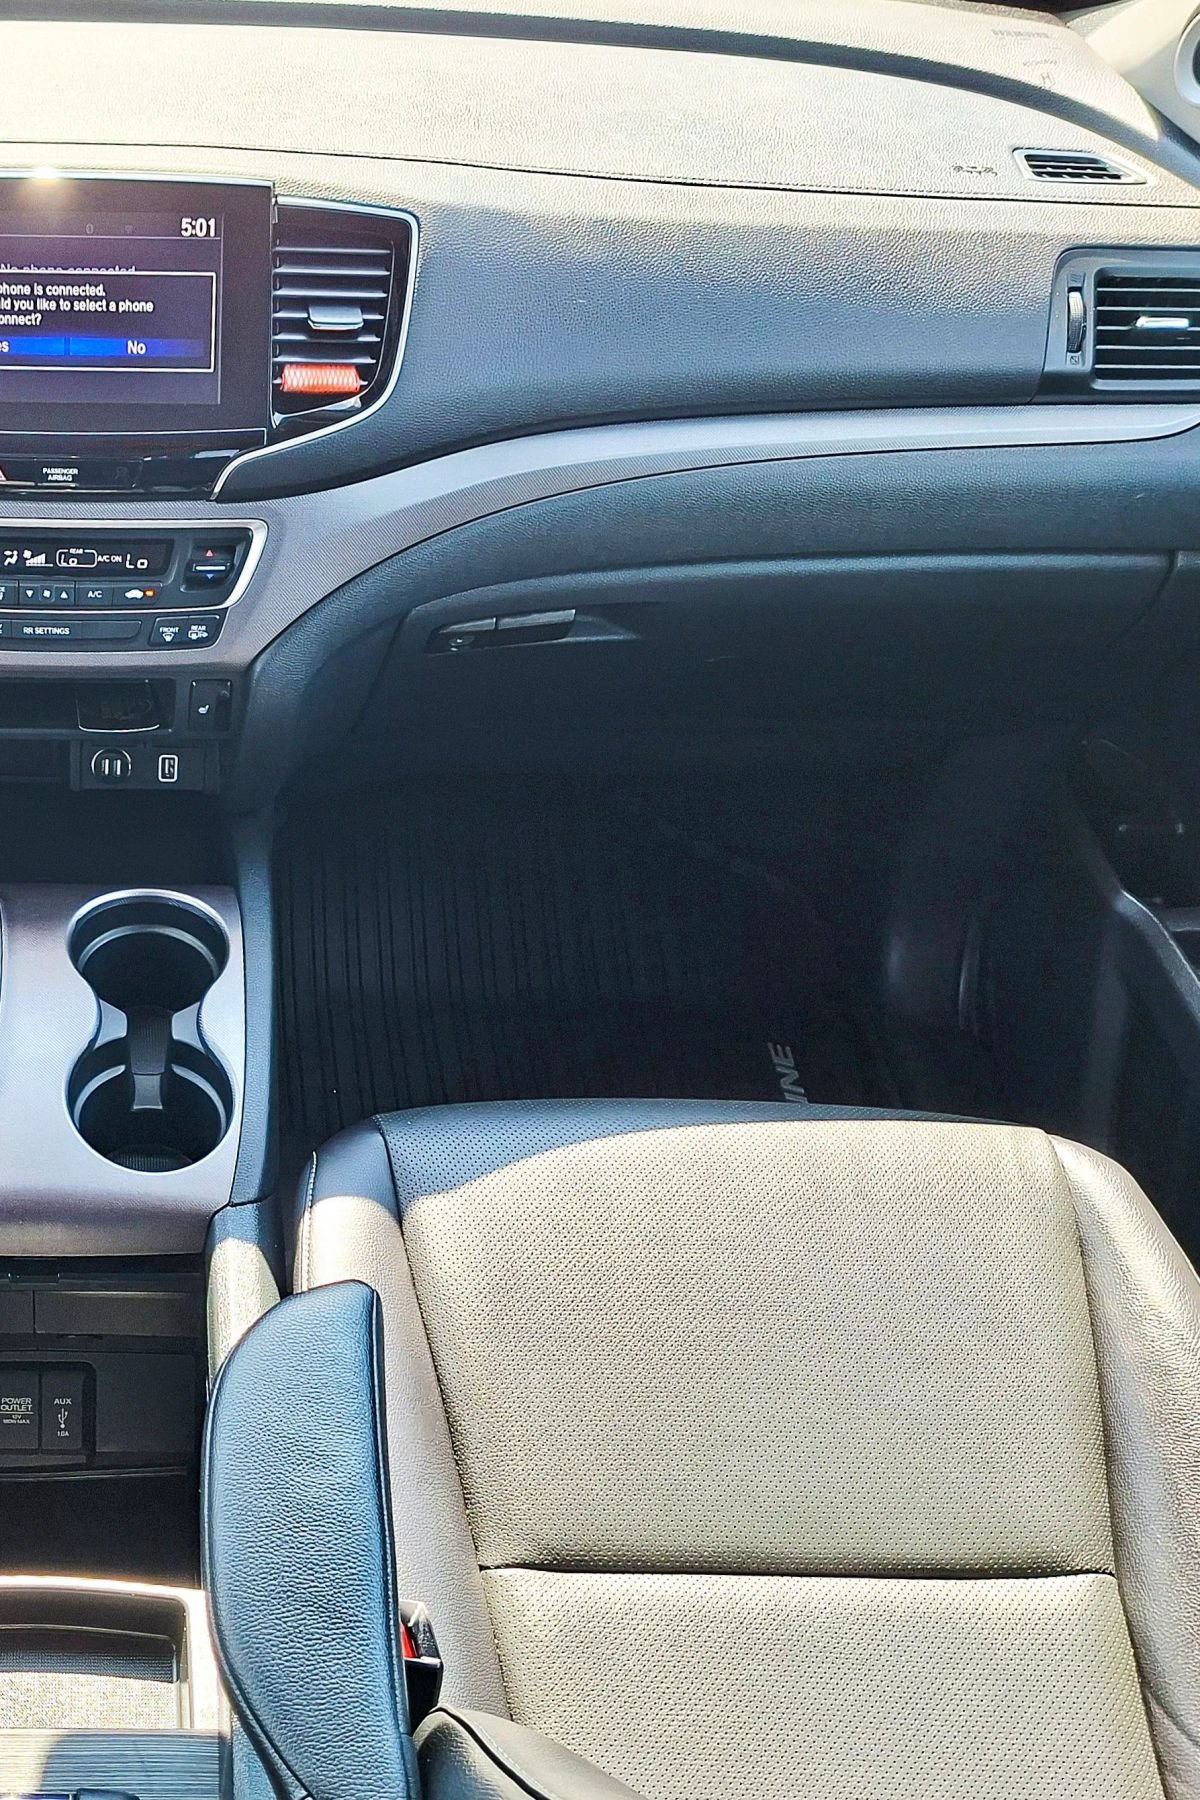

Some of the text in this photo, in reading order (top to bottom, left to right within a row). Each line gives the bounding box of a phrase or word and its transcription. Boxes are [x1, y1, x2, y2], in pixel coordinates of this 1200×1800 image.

[181, 217, 216, 238] 5:01
[34, 283, 44, 296] is
[45, 284, 106, 297] connected.
[13, 300, 34, 312] you
[36, 298, 57, 311] like
[59, 299, 71, 311] to
[73, 299, 107, 312] select
[109, 302, 117, 312] a
[119, 300, 154, 313] phone
[127, 340, 146, 354] No
[43, 467, 79, 475] PASSENGER
[48, 474, 73, 482] AIRBAG
[111, 555, 123, 563] ON
[125, 553, 148, 569] Lo
[87, 590, 103, 598] A/C
[23, 627, 70, 635] RR SETTINGS
[0, 1404, 32, 1412] OUTLET
